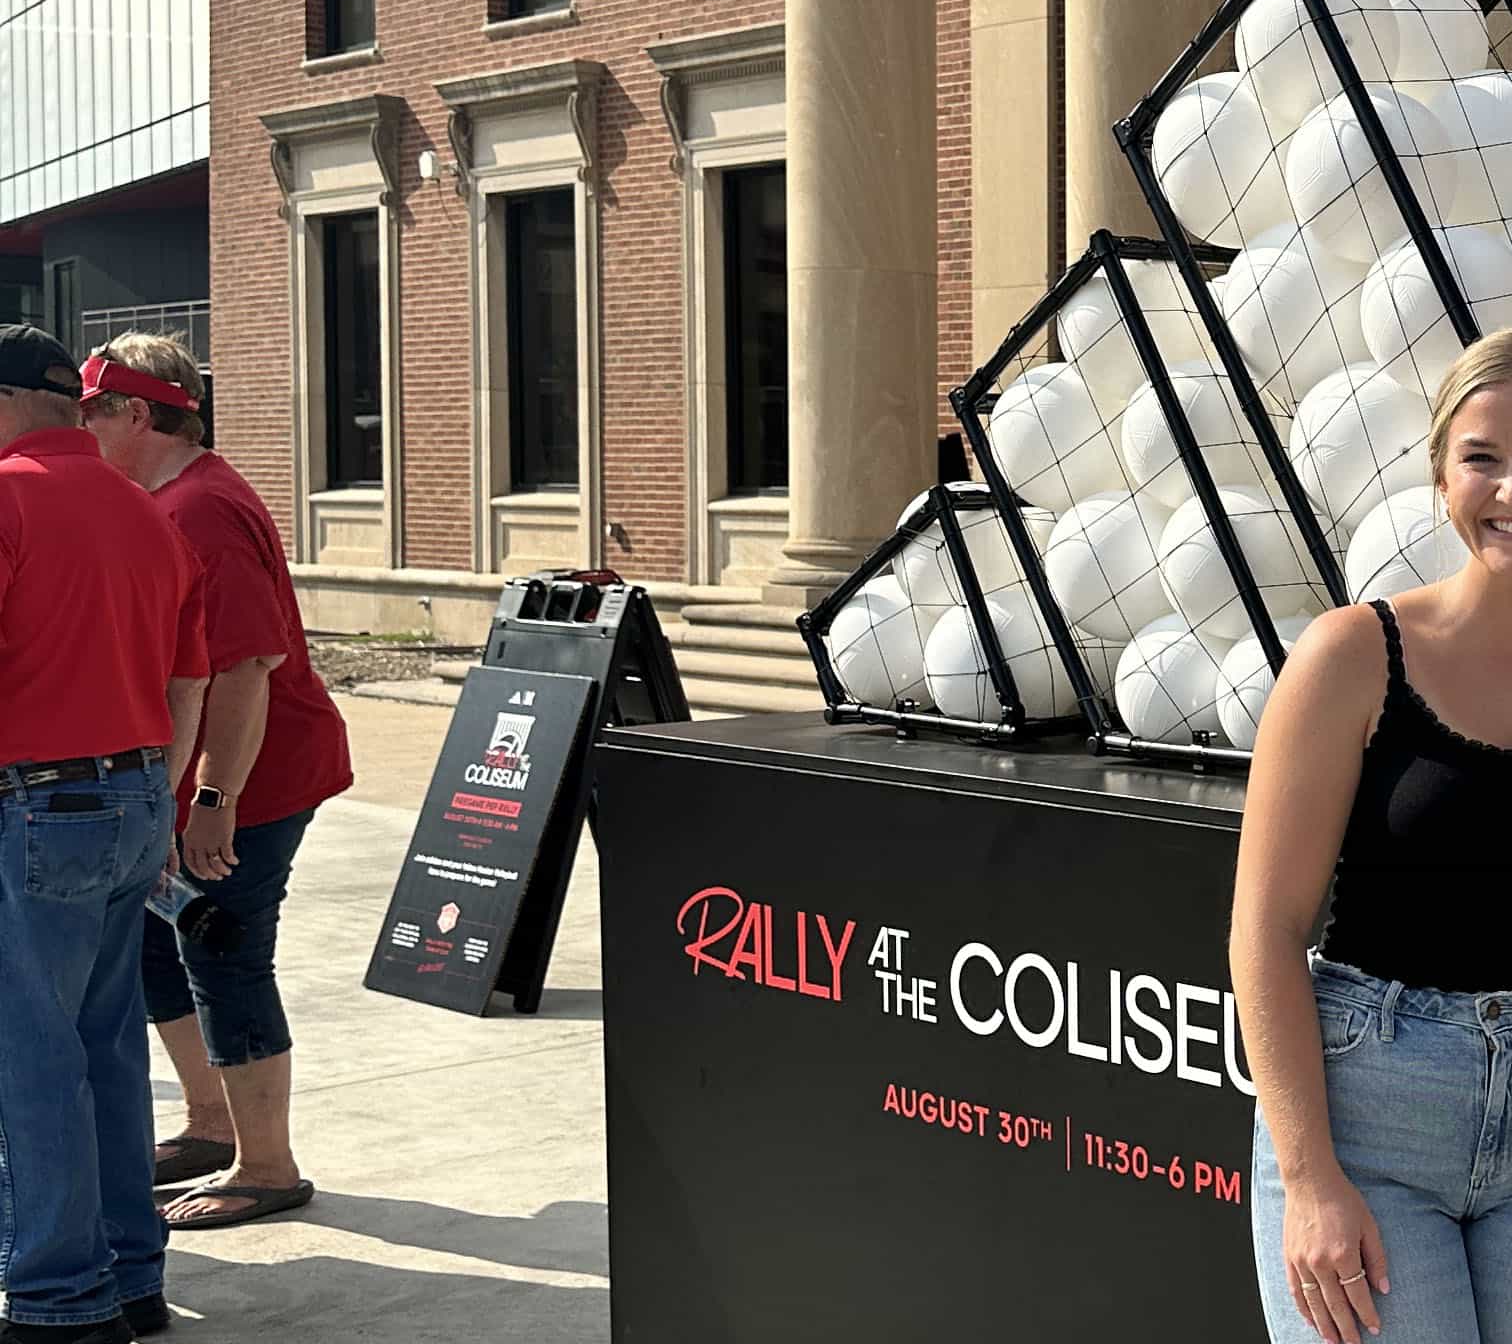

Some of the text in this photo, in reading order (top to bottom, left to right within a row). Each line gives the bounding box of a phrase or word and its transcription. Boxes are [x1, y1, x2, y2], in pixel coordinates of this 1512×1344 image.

[464, 763, 530, 791] COLISEUM
[676, 886, 1258, 1097] RALLY AT THE COLISEU
[883, 1084, 990, 1137] AUGUST
[998, 1112, 1053, 1148] 30TH
[1194, 1161, 1242, 1204] PM
